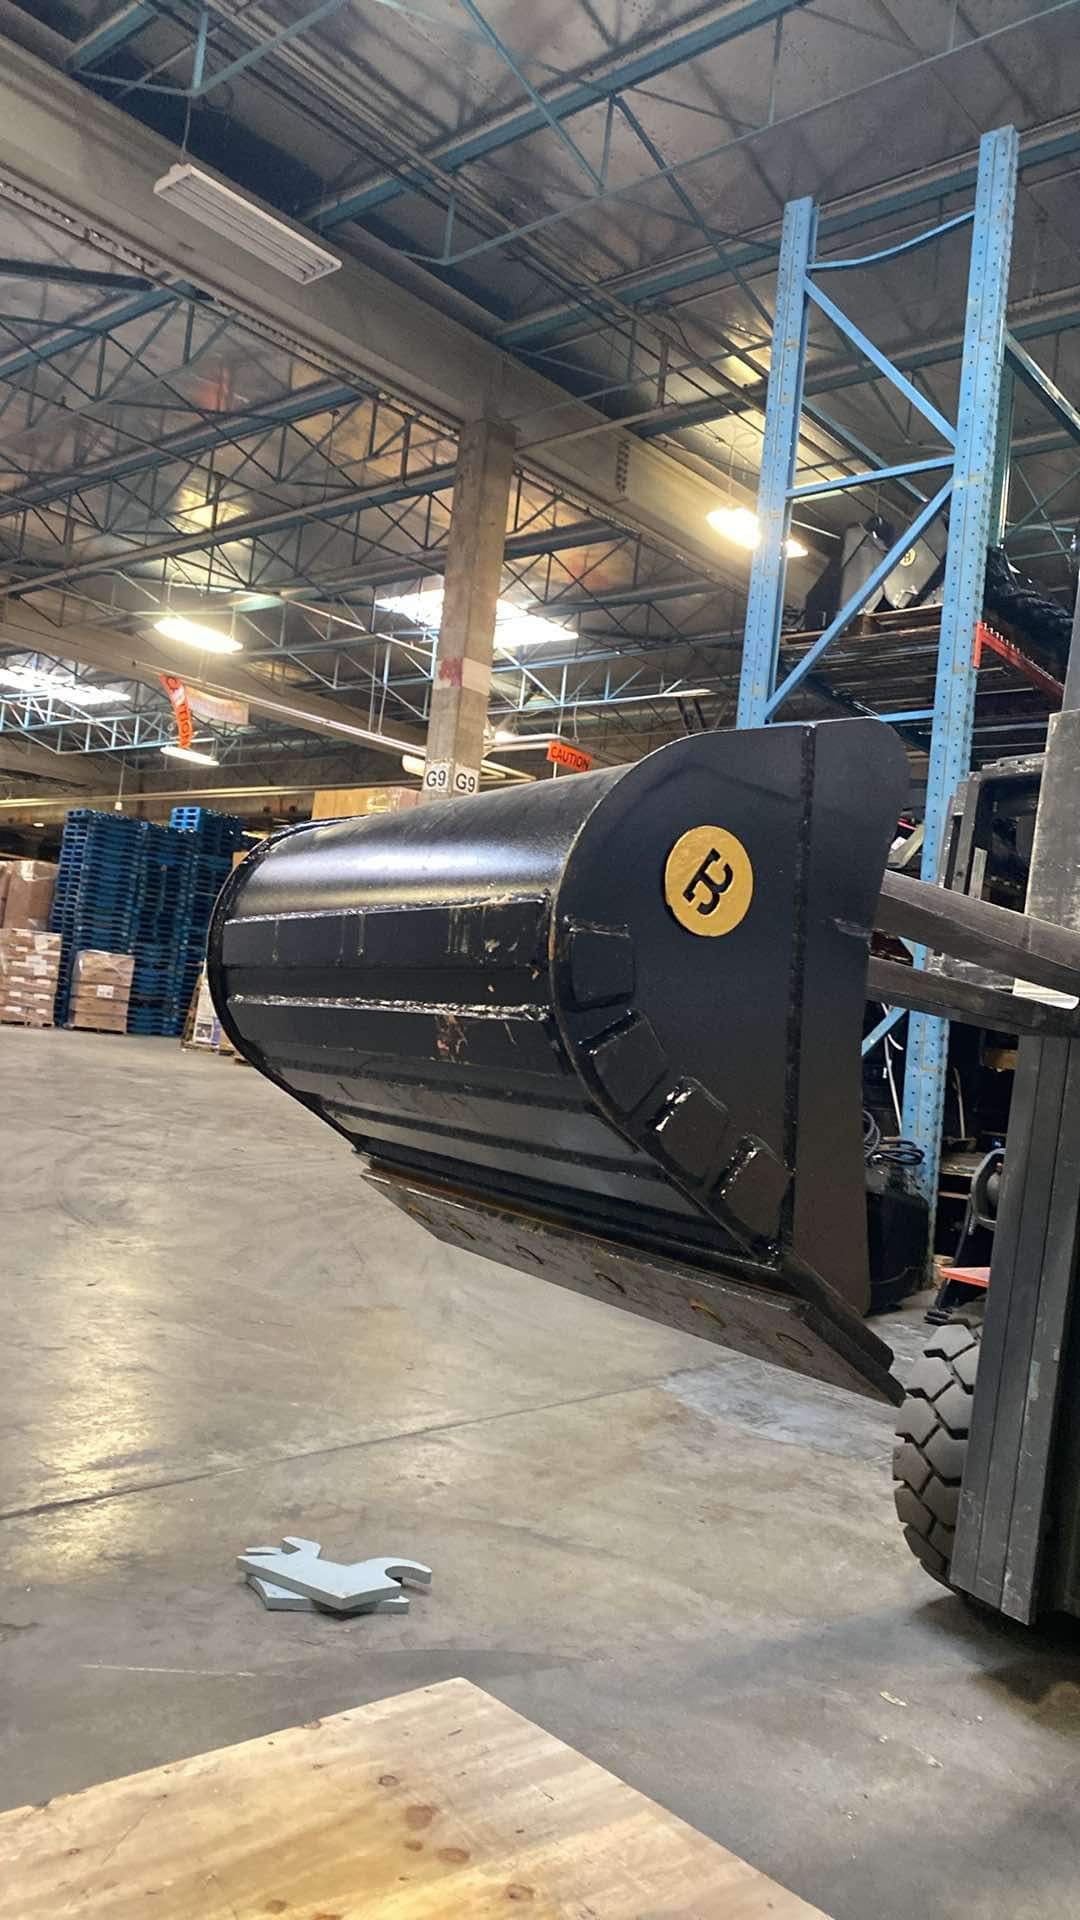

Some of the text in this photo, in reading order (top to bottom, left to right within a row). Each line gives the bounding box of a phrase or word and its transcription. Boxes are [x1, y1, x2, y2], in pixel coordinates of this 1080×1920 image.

[166, 676, 192, 747] CTION
[551, 746, 590, 770] CAUTION
[426, 770, 446, 788] G9
[456, 773, 475, 793] G9
